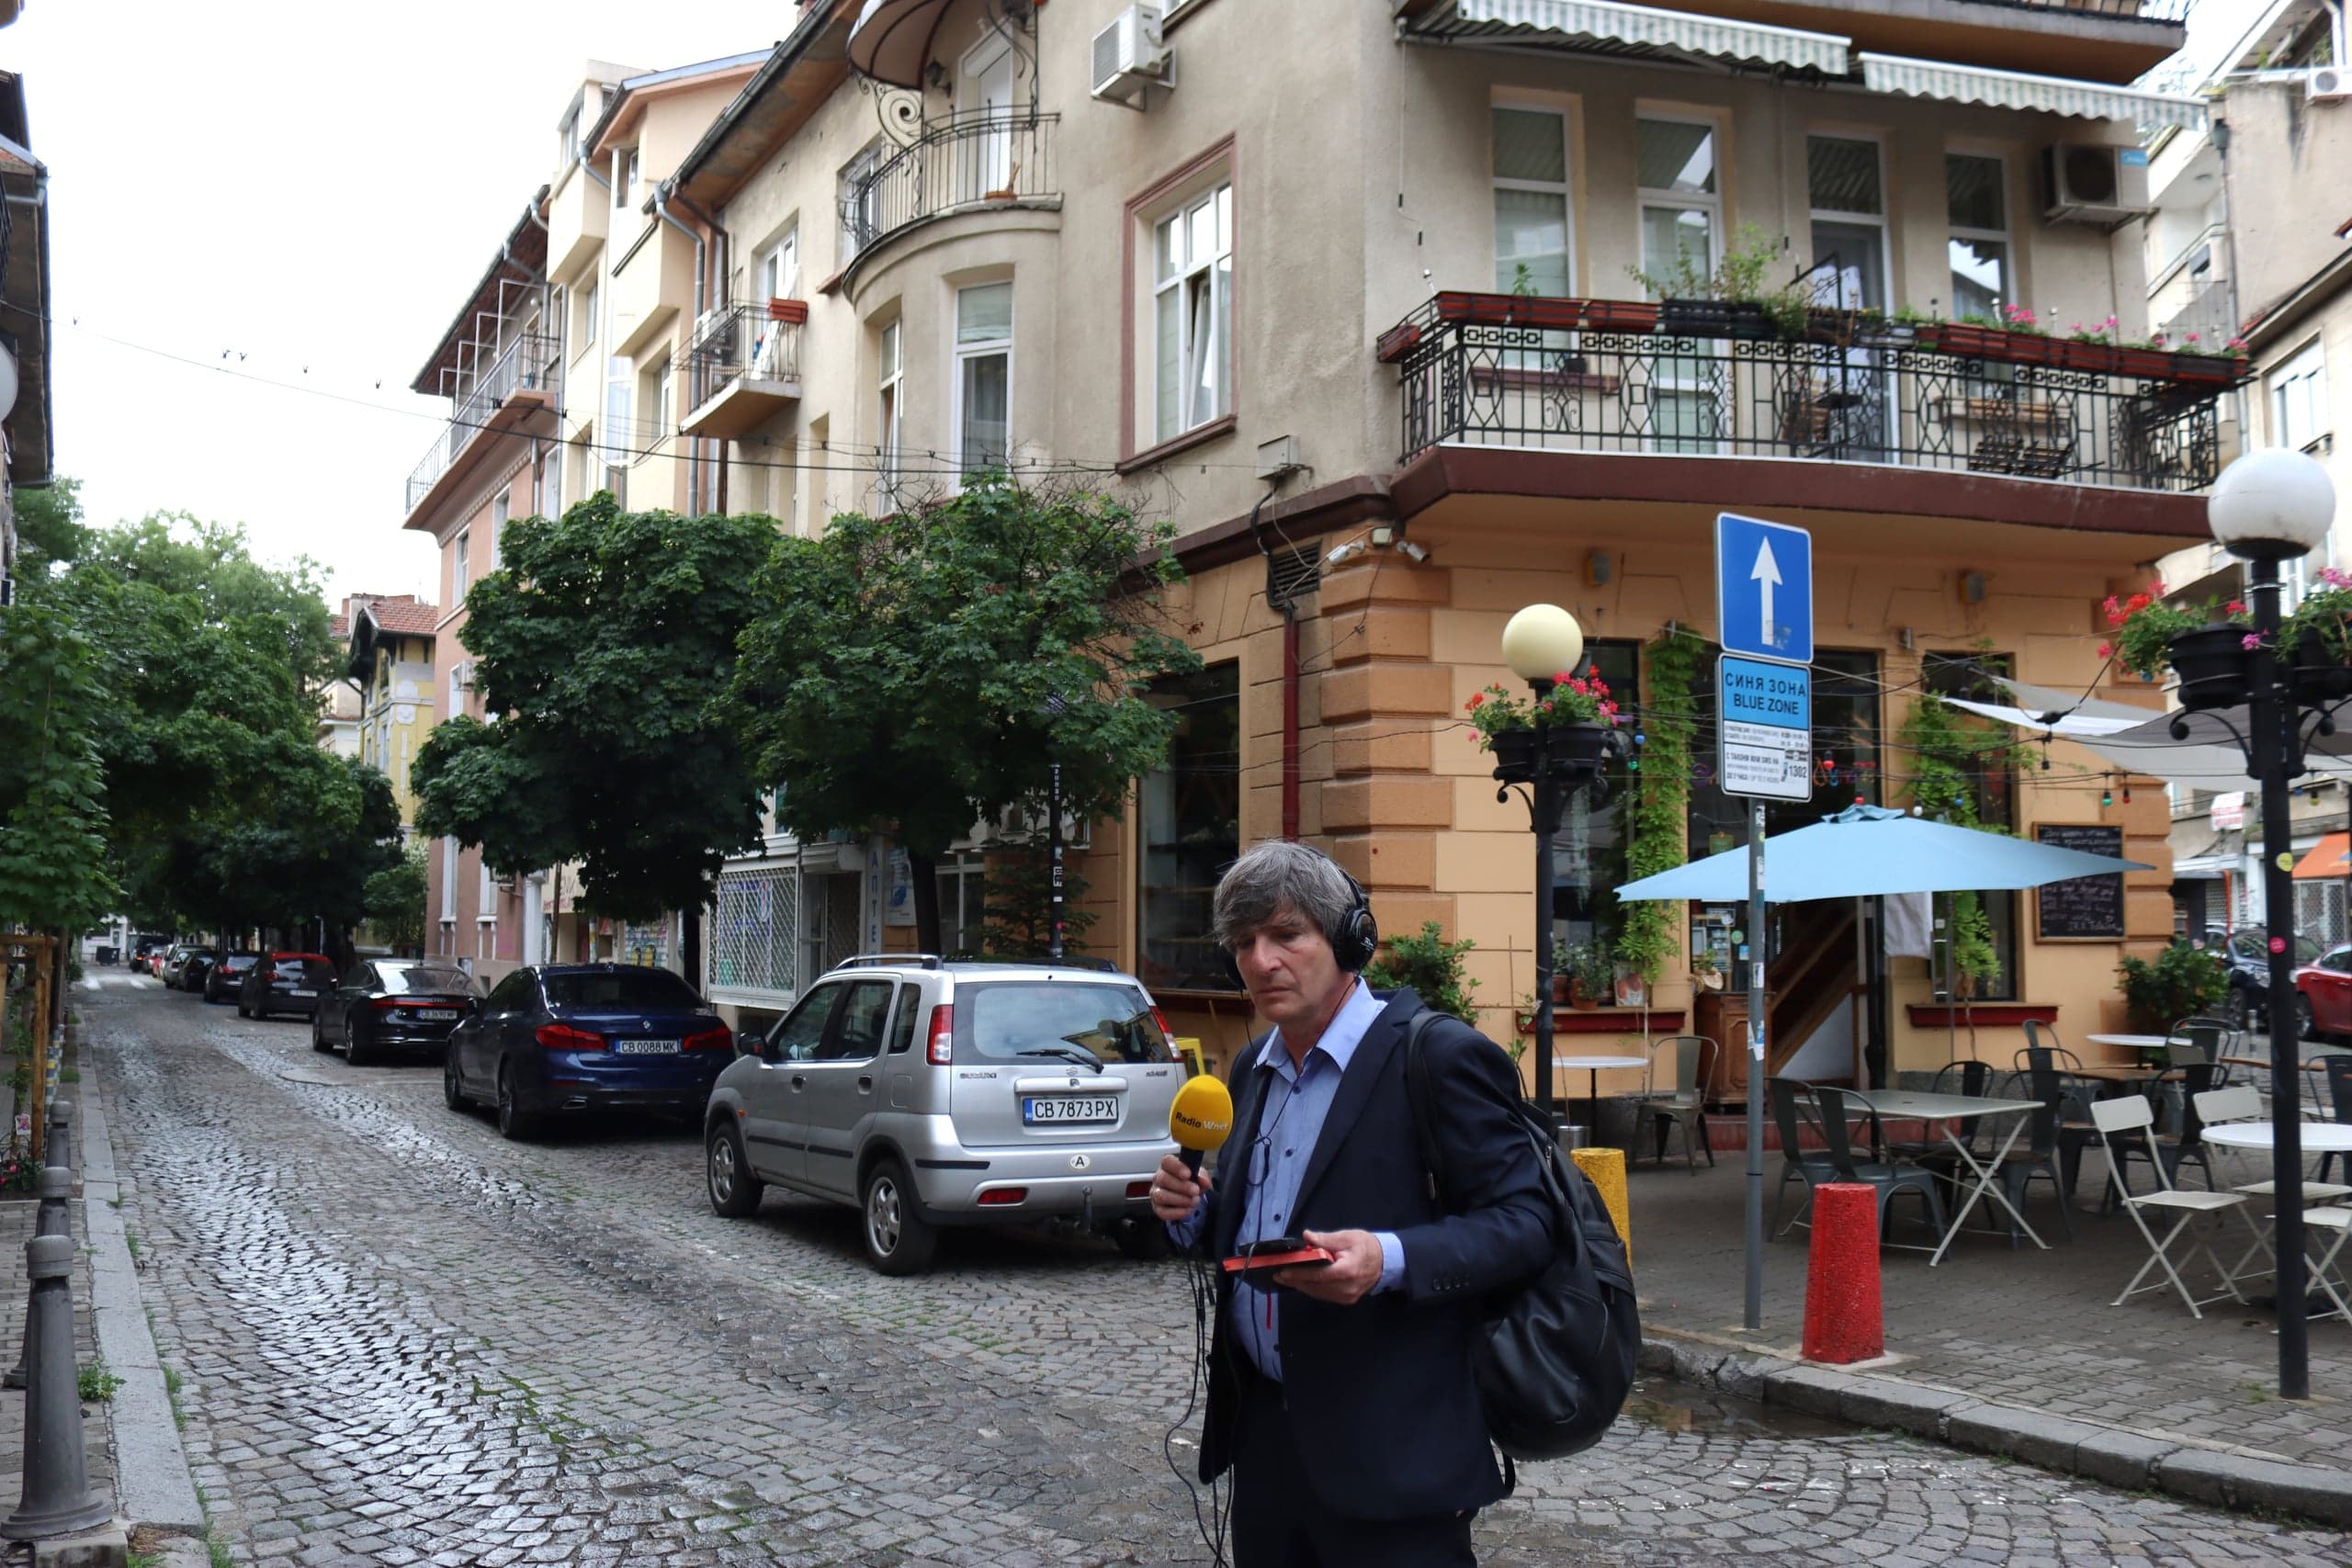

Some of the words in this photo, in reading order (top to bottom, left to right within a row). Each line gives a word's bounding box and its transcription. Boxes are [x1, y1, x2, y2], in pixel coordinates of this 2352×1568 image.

[1724, 672, 1764, 691] СИНЯ
[1769, 679, 1806, 697] ЗОНА
[1734, 693, 1764, 711] BLUE
[1768, 698, 1800, 715] ZONE
[1789, 765, 1807, 779] 1302
[621, 1043, 636, 1053] CB
[662, 1043, 675, 1053] MK
[1035, 1101, 1055, 1118] CB
[1057, 1101, 1092, 1118] 7873
[1095, 1100, 1114, 1117] PX
[1176, 1111, 1202, 1128] Radio
[1204, 1121, 1228, 1131] Wnet
[1075, 1156, 1085, 1167] A
